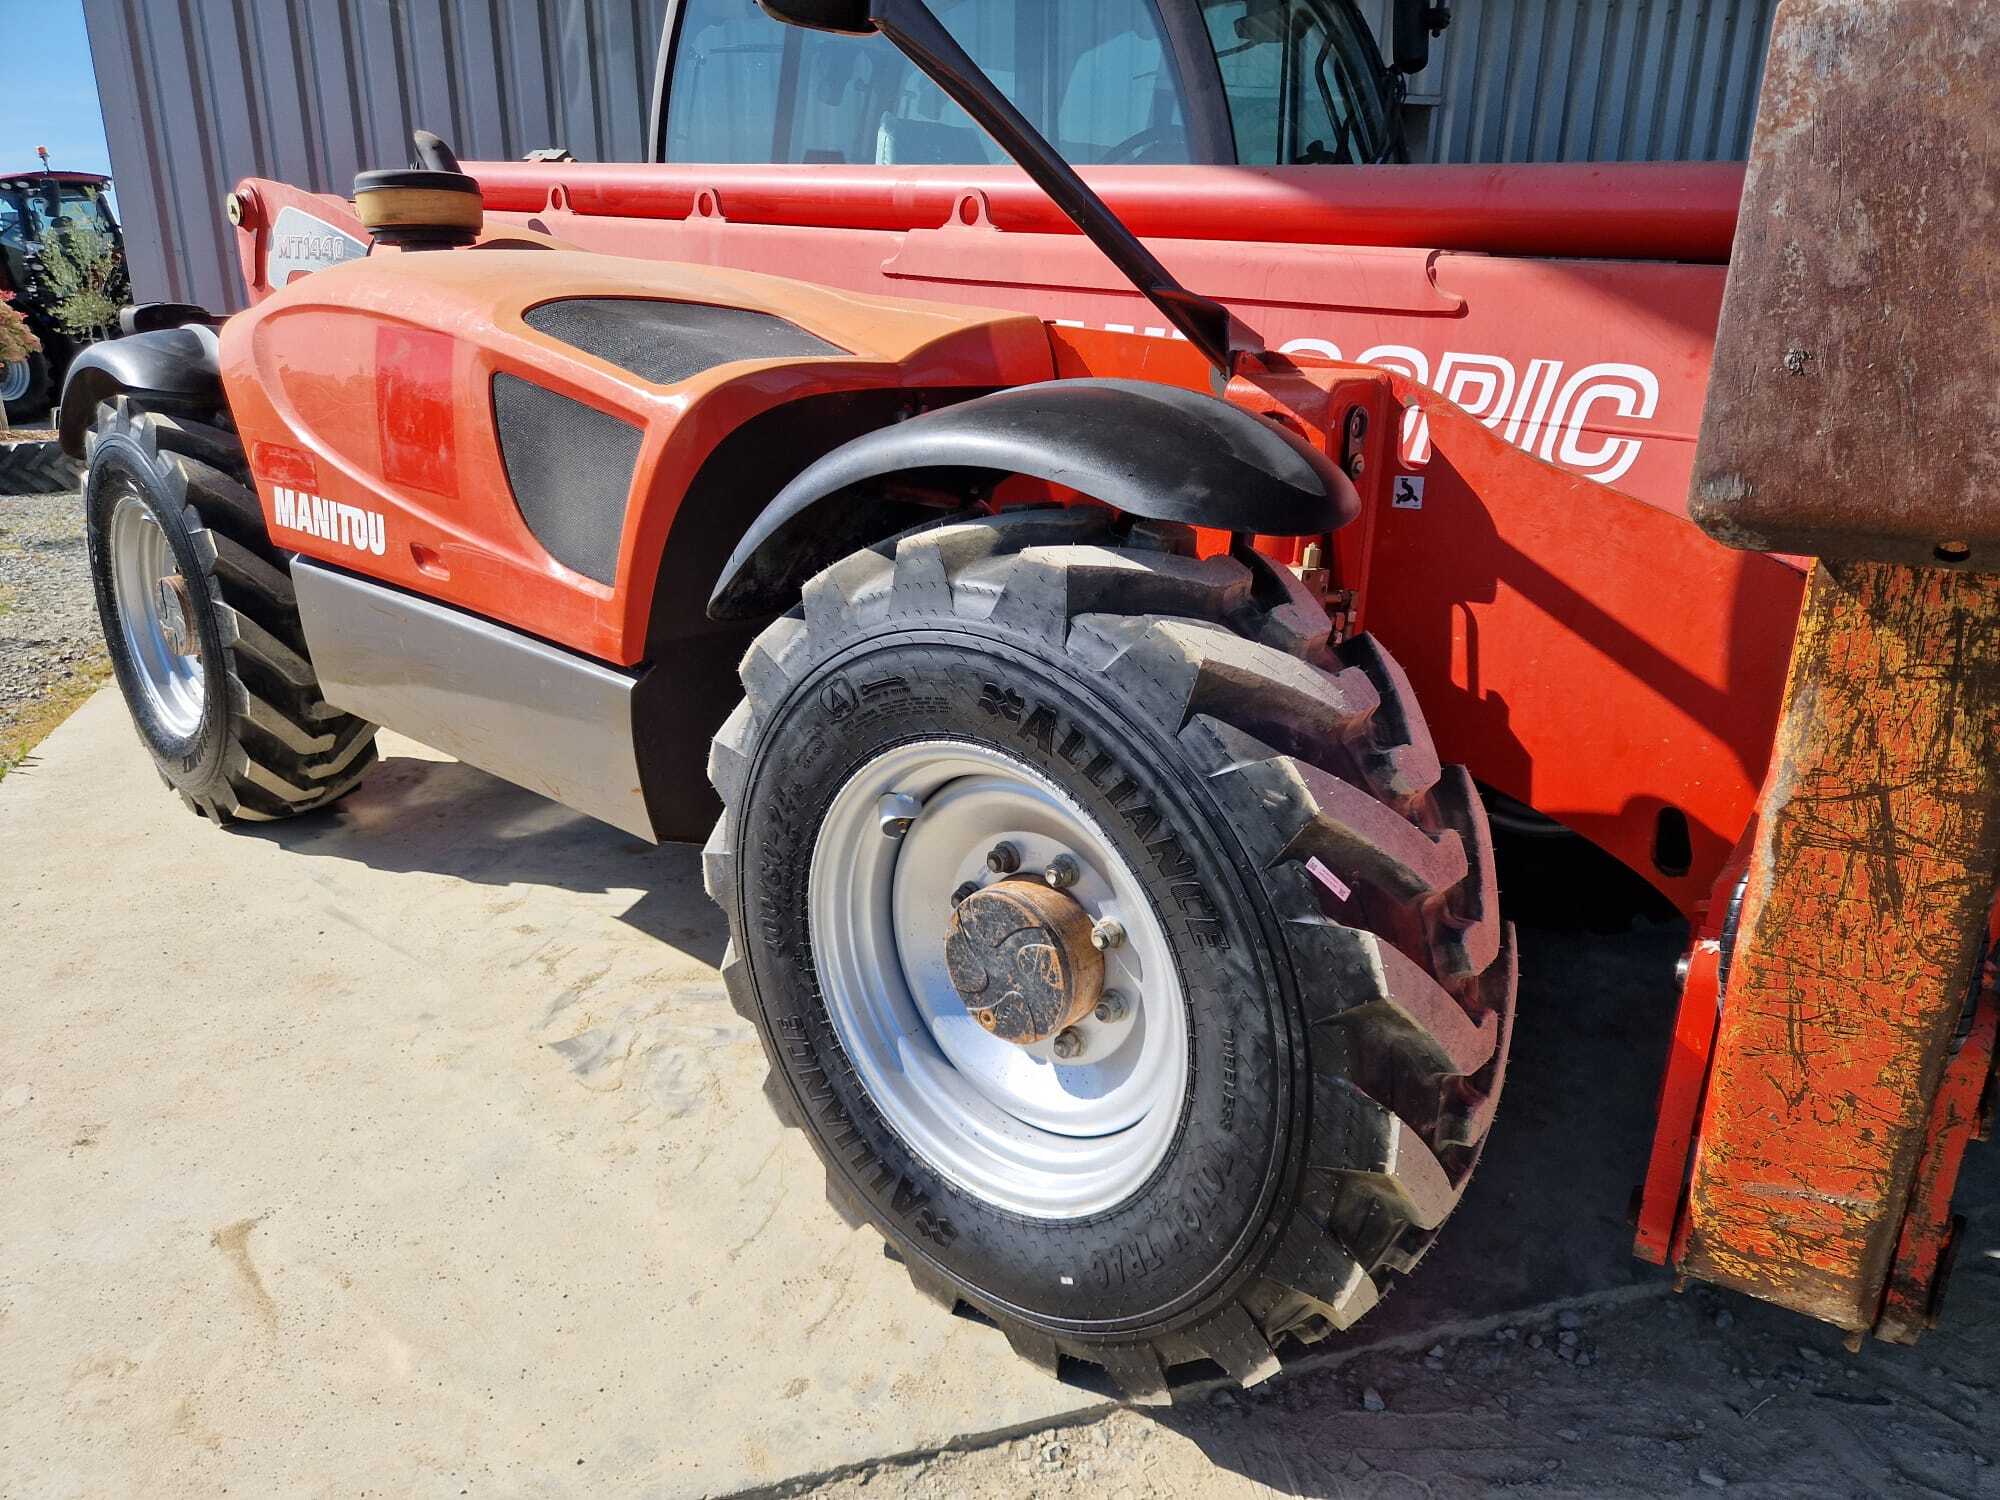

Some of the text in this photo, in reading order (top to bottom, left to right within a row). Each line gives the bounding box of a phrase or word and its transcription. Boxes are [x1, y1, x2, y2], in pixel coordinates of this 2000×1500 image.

[279, 233, 344, 260] MT1440
[274, 486, 386, 555] MANITOU
[1016, 704, 1231, 950] ALLIANCE
[776, 1013, 930, 1219] ALLIANCE
[1218, 1027, 1237, 1133] TUBELESS
